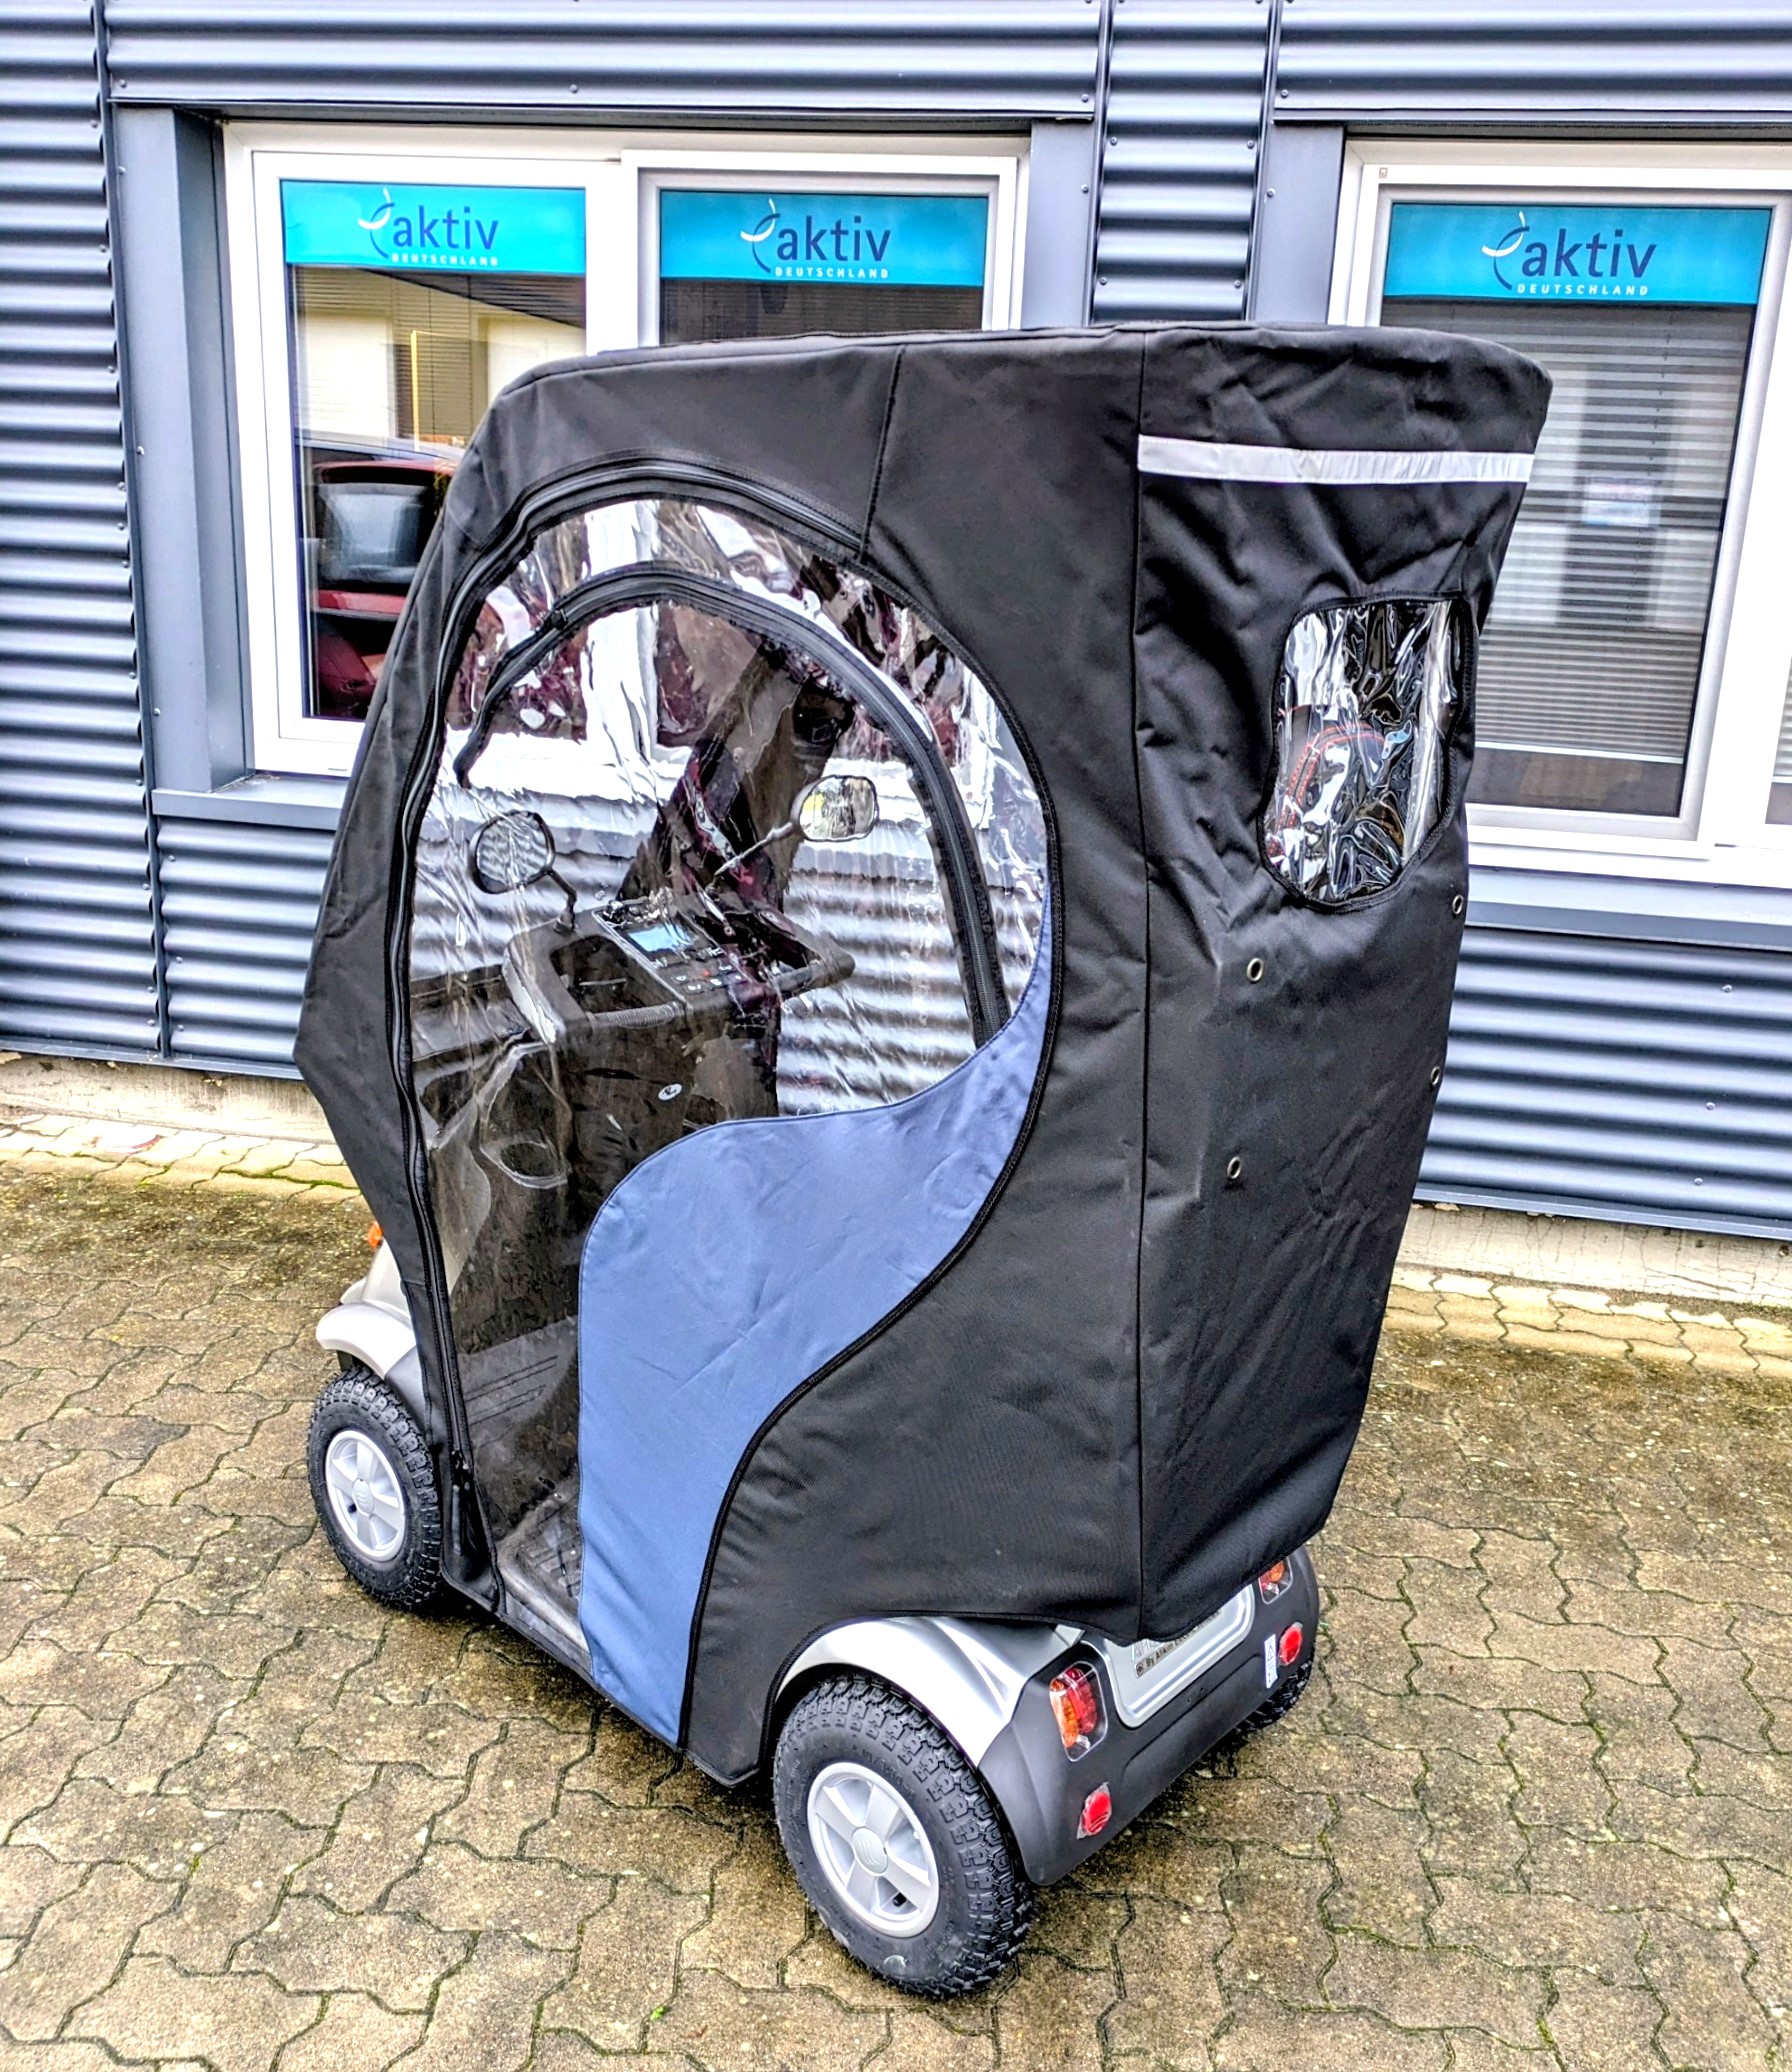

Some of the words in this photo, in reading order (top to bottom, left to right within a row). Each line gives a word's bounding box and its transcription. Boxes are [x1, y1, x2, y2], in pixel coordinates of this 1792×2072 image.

[393, 205, 499, 250] aktiv
[776, 215, 891, 262] aktiv
[391, 252, 499, 267] DEUTSCHLAND
[1521, 228, 1657, 278] aktiv
[775, 266, 889, 279] DEUTSCHLAND
[1517, 283, 1649, 296] DEUTSCHLAND
